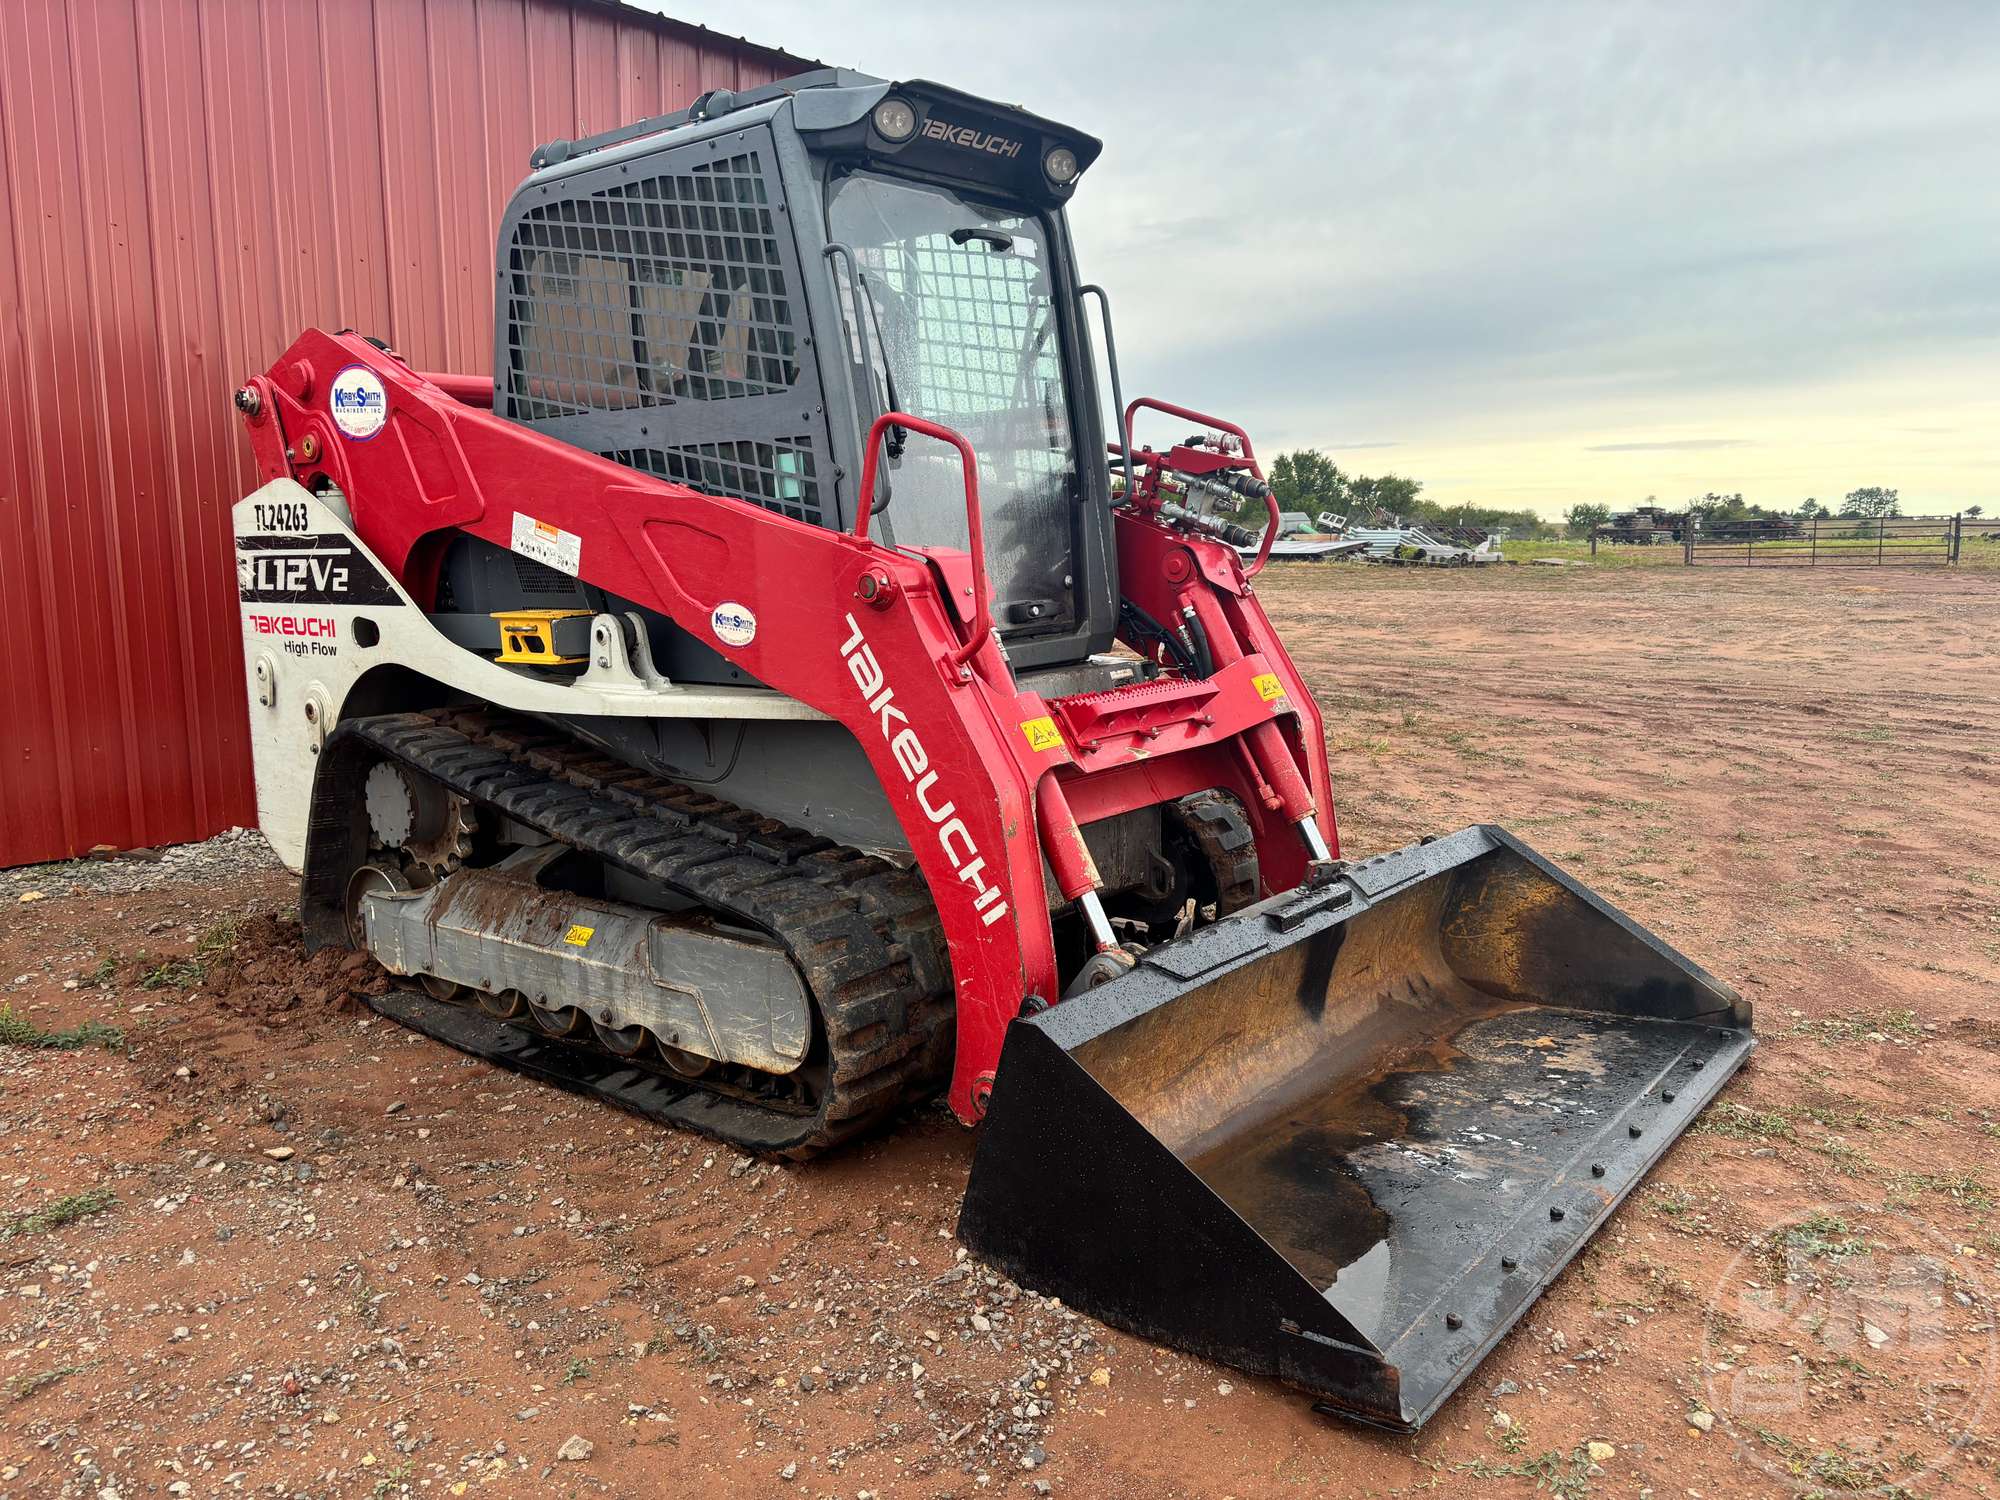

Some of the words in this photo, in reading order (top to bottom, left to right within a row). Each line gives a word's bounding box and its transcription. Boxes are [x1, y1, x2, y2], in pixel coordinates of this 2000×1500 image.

[254, 503, 309, 531] TL24263
[284, 641, 309, 657] High
[311, 642, 337, 656] Flow
